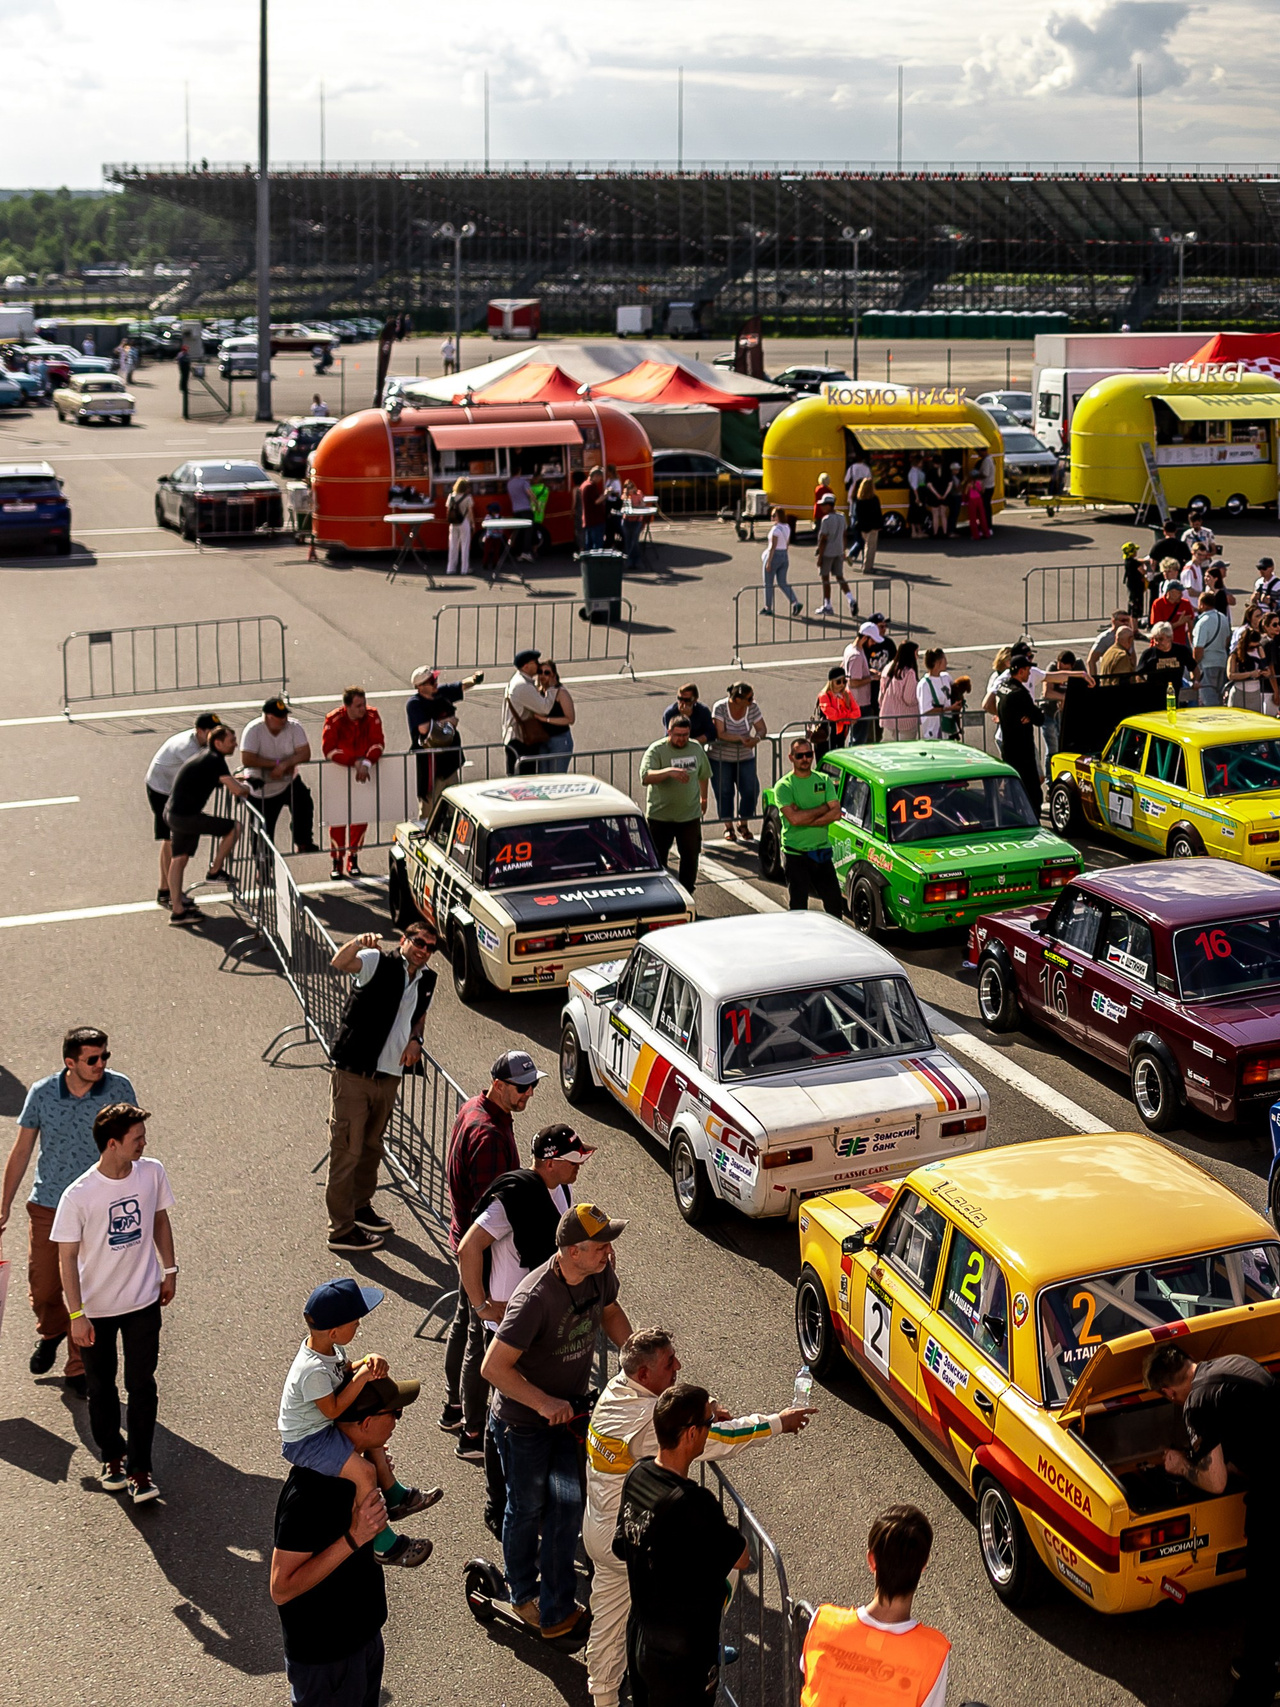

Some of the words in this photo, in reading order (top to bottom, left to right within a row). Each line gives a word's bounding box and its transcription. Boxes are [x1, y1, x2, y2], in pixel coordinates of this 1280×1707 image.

[1168, 362, 1246, 384] KURGI
[826, 388, 897, 406] KOSMO
[907, 387, 968, 406] TRACK
[1216, 764, 1228, 786] 7
[892, 795, 933, 824] 13
[1117, 797, 1124, 820] 7
[456, 818, 469, 843] 49
[495, 842, 533, 863] 49
[934, 838, 1039, 860] rebina
[502, 860, 533, 872] КАРАНИК
[584, 929, 633, 942] YOKOHAMA
[1195, 929, 1232, 961] 16
[1039, 963, 1069, 1021] 16
[725, 1009, 752, 1046] 11
[612, 1032, 624, 1078] 11
[705, 1115, 759, 1167] CCR
[872, 1126, 917, 1142] Земский
[872, 1141, 897, 1152] банк
[728, 1169, 742, 1182] банк
[730, 1158, 752, 1177] Земский
[834, 1169, 867, 1181] CLASSIC
[868, 1165, 889, 1176] CARS
[944, 1187, 987, 1229] Lada
[960, 1251, 985, 1304] 2
[870, 1301, 884, 1358] 2
[1072, 1291, 1102, 1345] 2
[941, 1370, 956, 1391] банк
[943, 1355, 968, 1386] Земский
[1037, 1454, 1092, 1518] МОСКВА
[1043, 1527, 1078, 1567] СССР
